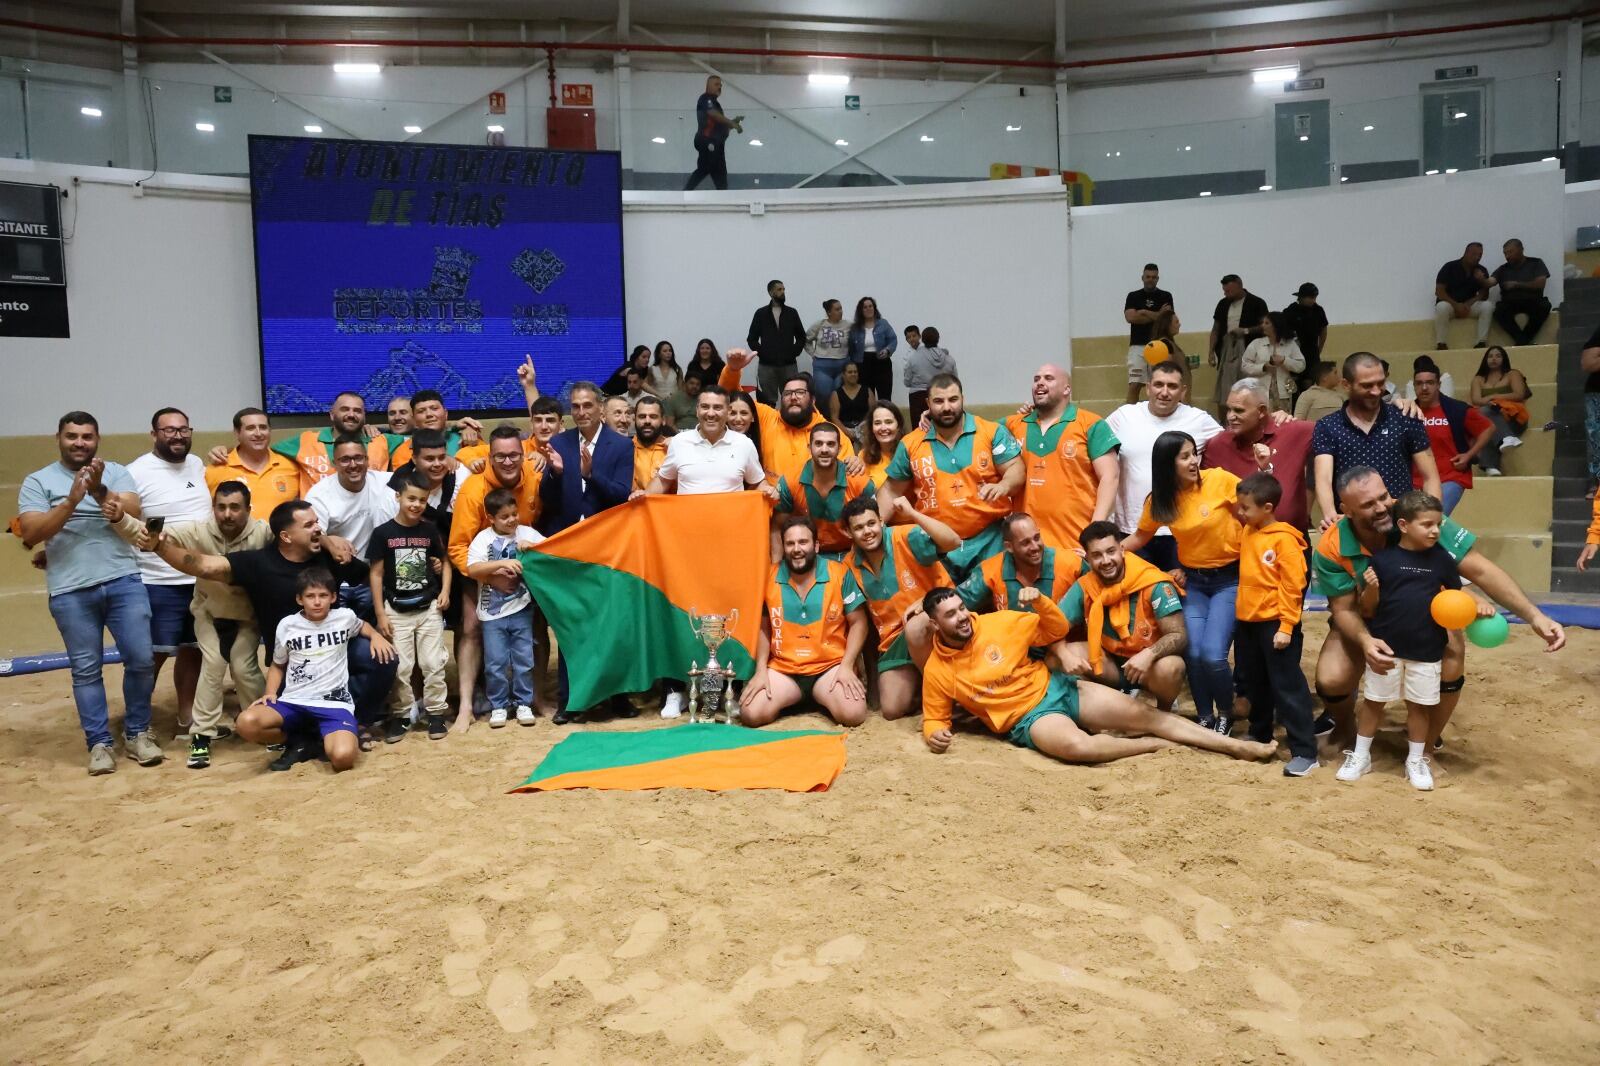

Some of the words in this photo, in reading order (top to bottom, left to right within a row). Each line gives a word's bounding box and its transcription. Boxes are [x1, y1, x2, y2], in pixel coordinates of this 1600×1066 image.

[366, 189, 417, 226] DE
[333, 300, 483, 320] DEPORTES
[1423, 416, 1449, 426] idas
